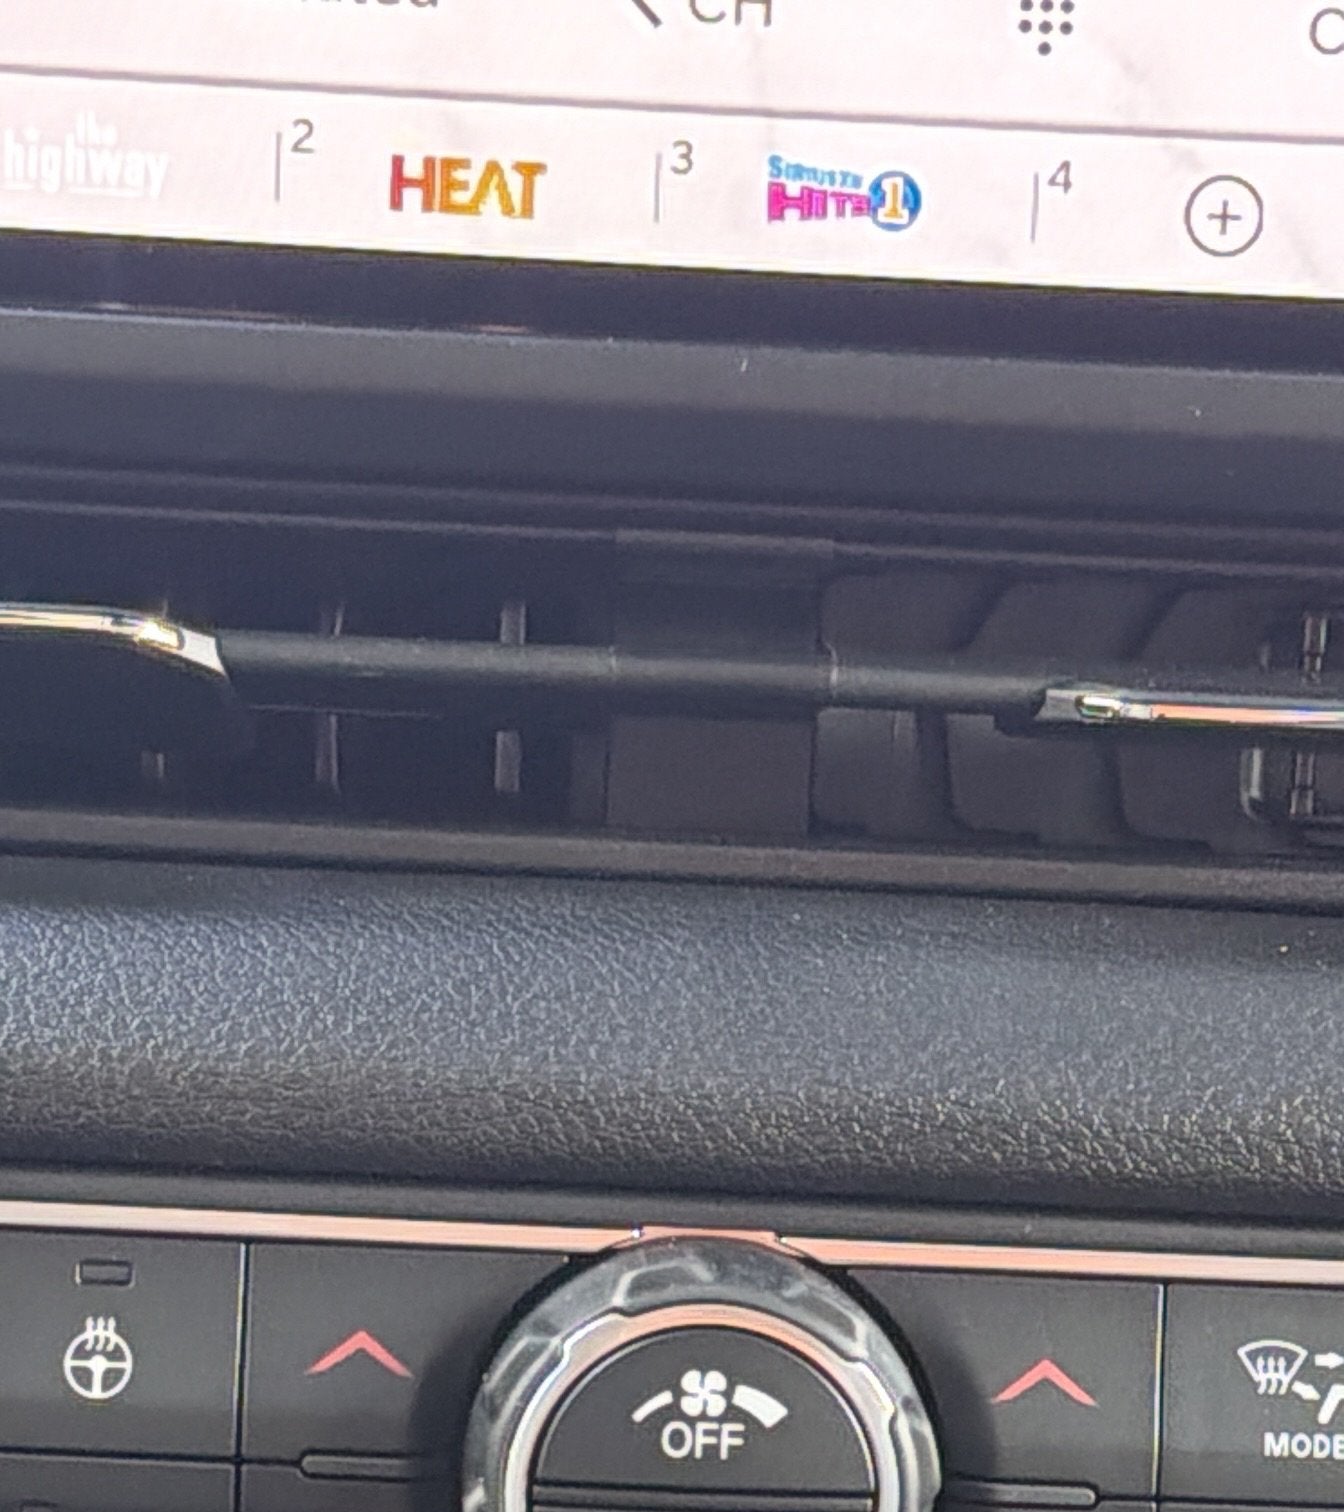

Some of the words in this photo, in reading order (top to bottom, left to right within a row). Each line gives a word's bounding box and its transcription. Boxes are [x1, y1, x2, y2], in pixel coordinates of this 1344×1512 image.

[290, 118, 315, 154] 2
[4, 128, 171, 198] highway
[669, 140, 694, 175] 3
[1047, 160, 1073, 193] 4
[389, 154, 547, 219] HEAT
[660, 1420, 747, 1460] OFF
